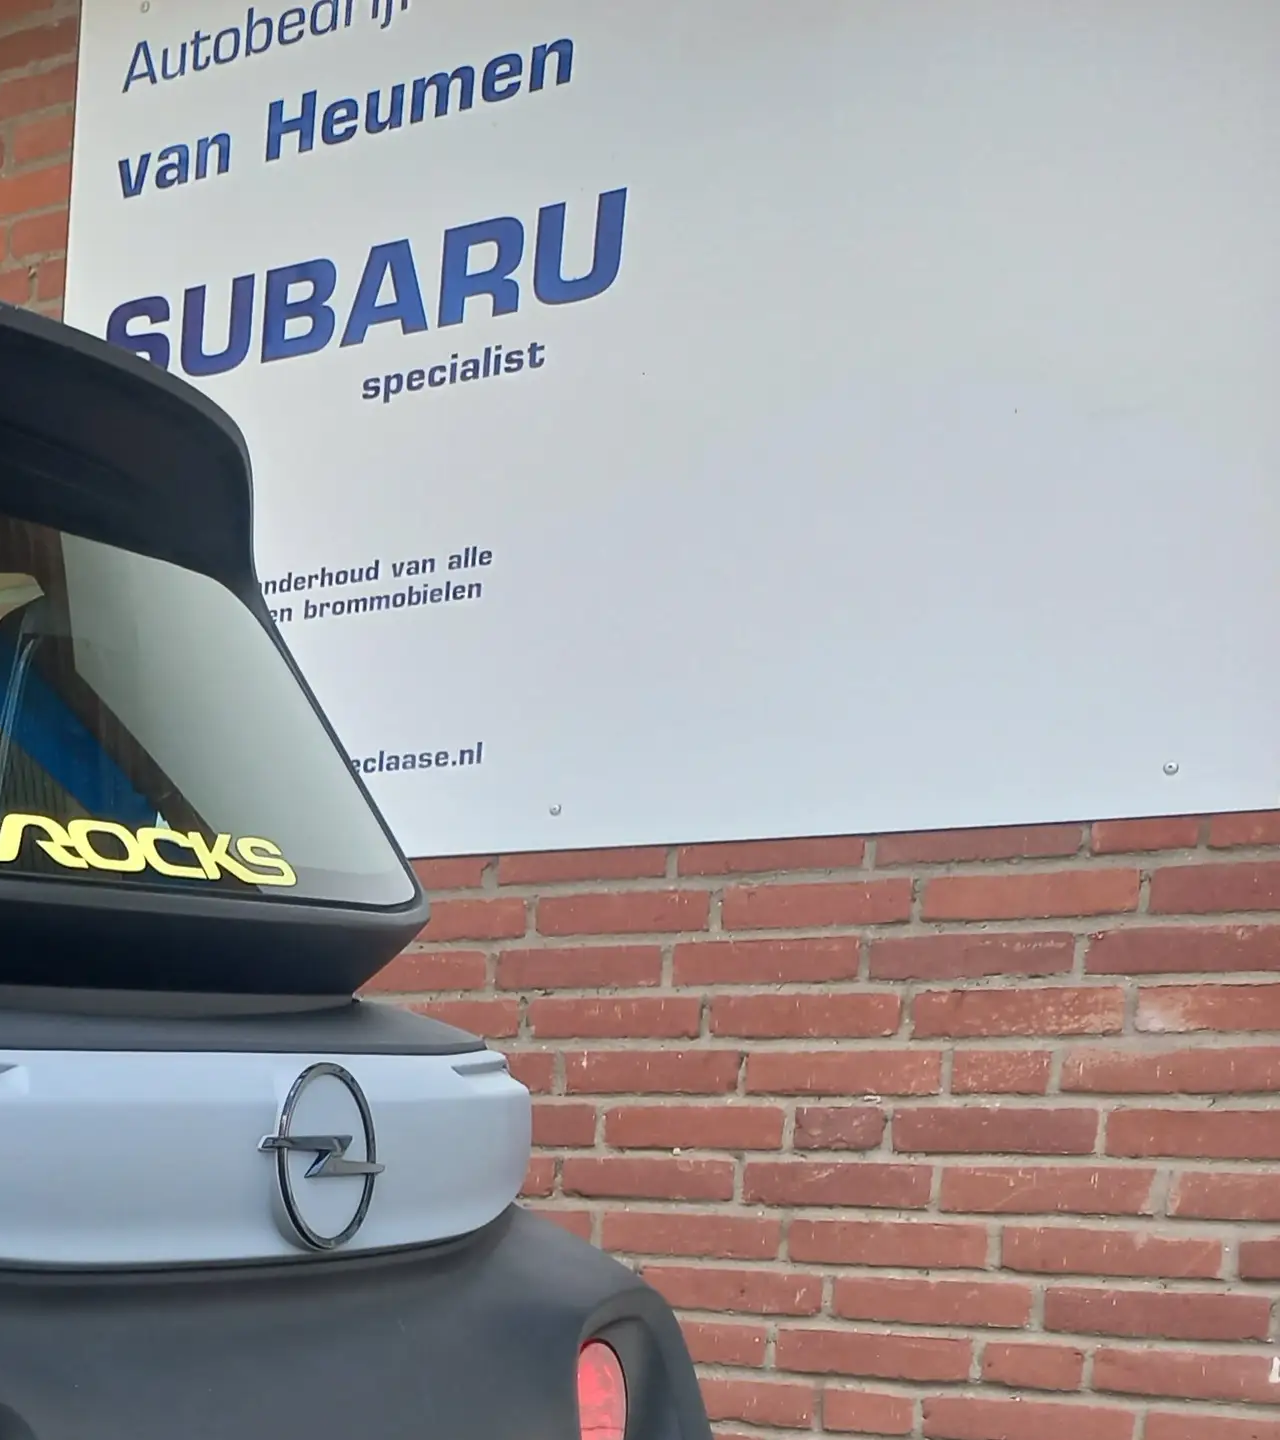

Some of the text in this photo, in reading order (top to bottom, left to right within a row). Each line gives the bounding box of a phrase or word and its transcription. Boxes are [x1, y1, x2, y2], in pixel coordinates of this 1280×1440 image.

[118, 37, 575, 198] van Heumen
[106, 187, 628, 377] SUBARU
[361, 341, 546, 403] specialist
[259, 546, 493, 595] nderhoud van alle
[304, 580, 482, 620] brommobielen
